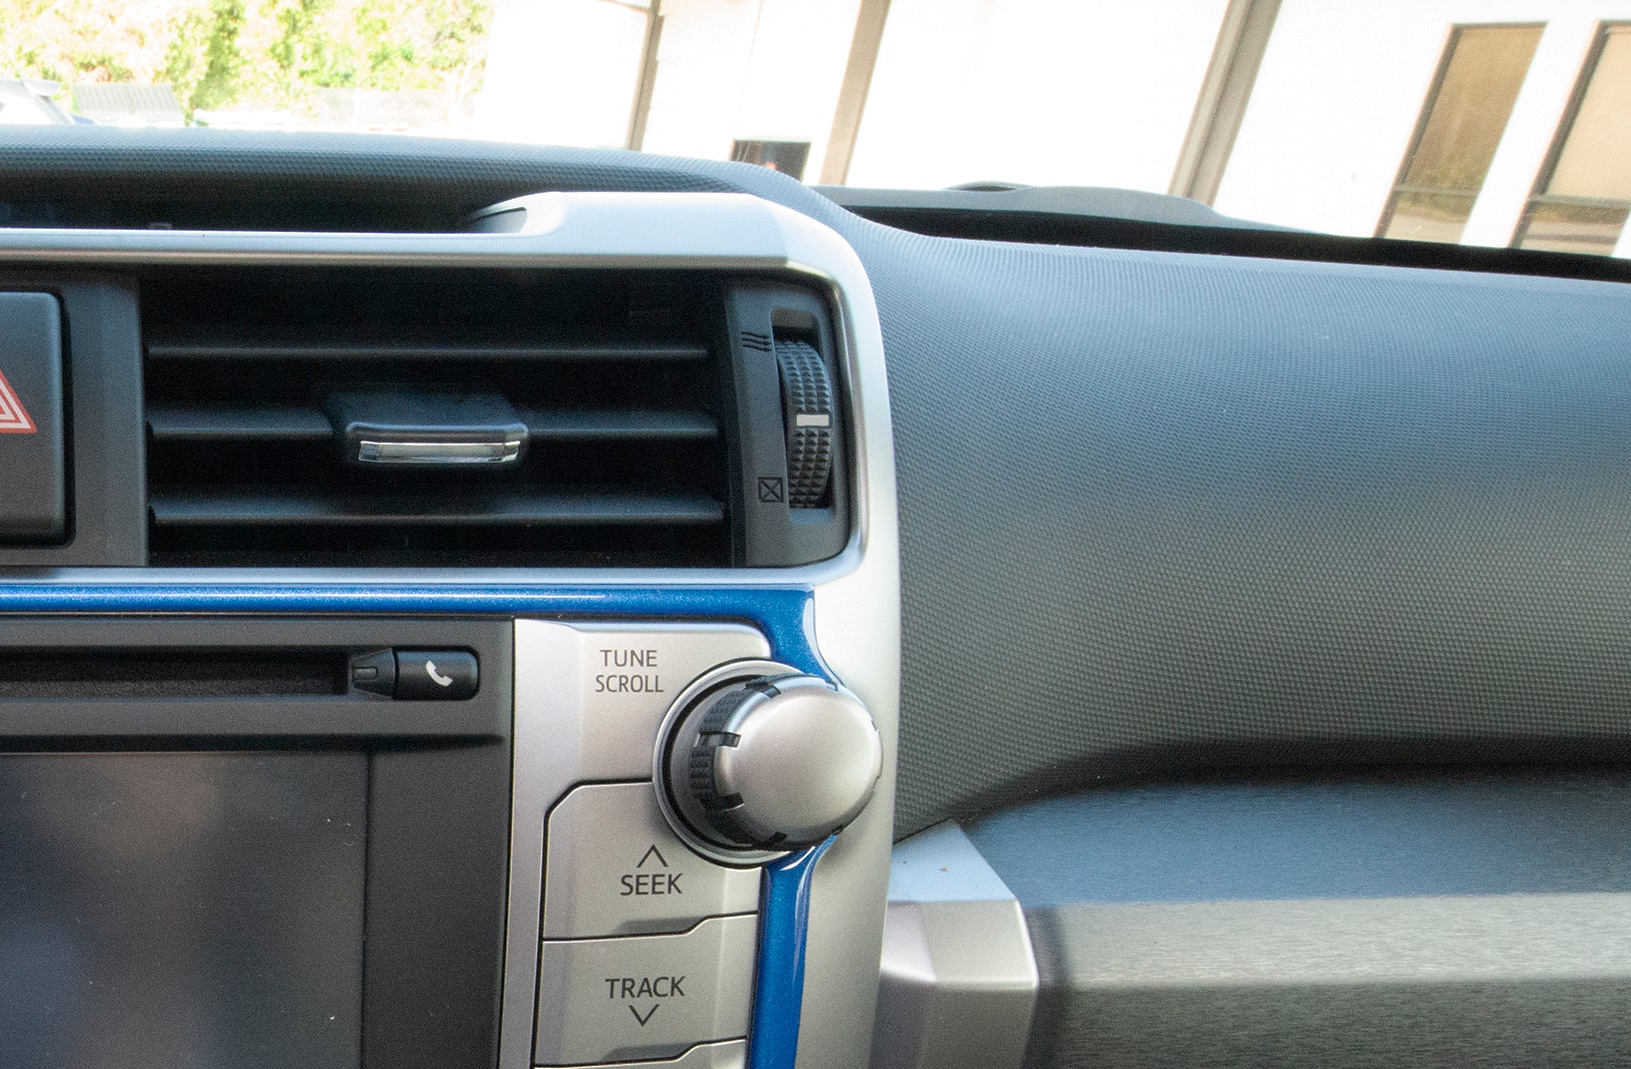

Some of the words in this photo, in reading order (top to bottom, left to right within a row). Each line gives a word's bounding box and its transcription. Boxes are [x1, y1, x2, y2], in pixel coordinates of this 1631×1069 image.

[599, 648, 659, 667] TUNE
[595, 673, 664, 694] SCROLL
[619, 873, 683, 896] SEEK
[605, 975, 686, 999] TRACK
